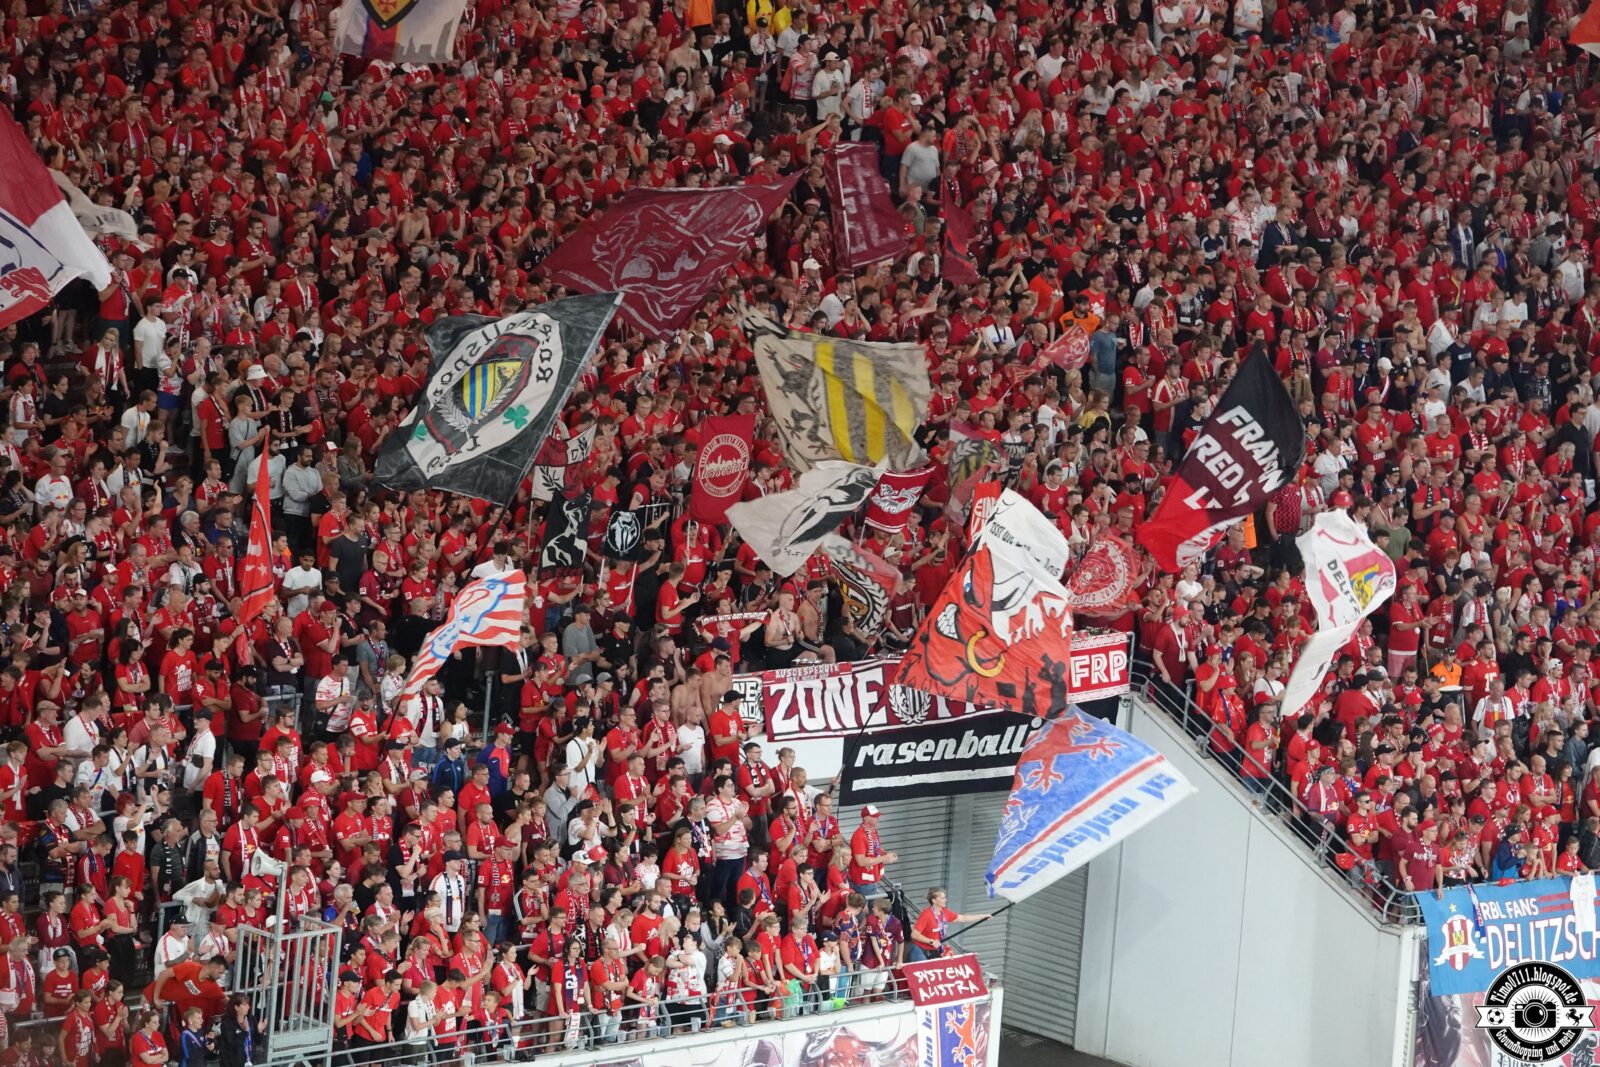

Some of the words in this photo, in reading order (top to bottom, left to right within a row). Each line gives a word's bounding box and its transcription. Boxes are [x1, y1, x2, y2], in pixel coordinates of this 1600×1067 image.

[1194, 433, 1245, 490] RED
[1070, 650, 1128, 688] FRP
[768, 666, 889, 734] ZONE
[852, 715, 1044, 769] rasenballi
[1481, 902, 1506, 921] RBL
[1507, 898, 1540, 919] FANS
